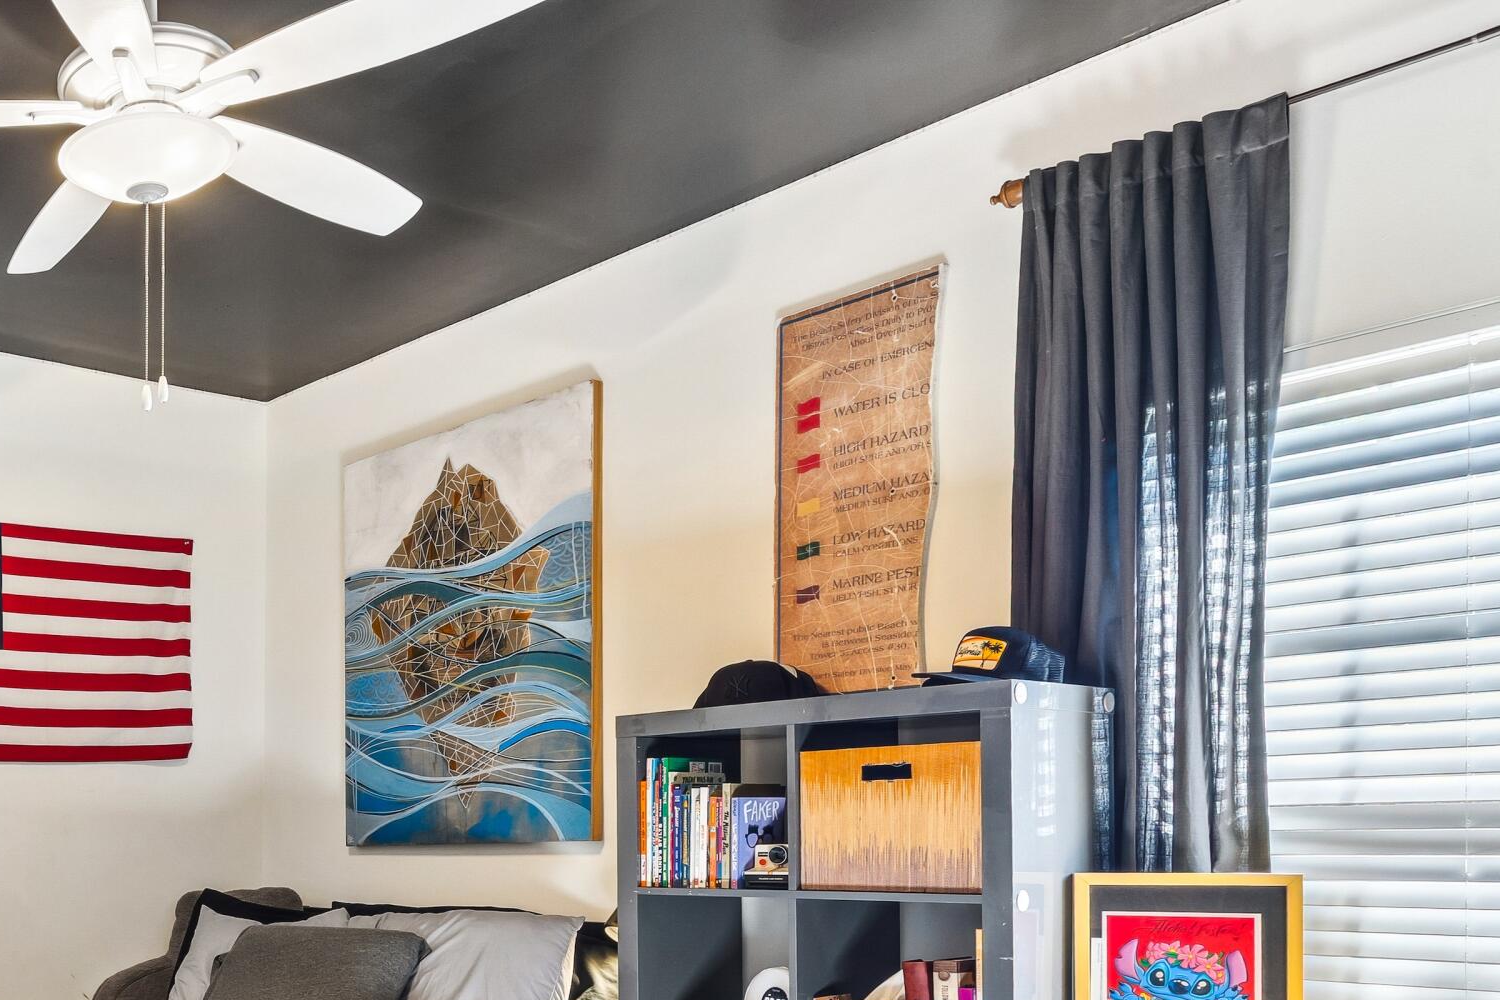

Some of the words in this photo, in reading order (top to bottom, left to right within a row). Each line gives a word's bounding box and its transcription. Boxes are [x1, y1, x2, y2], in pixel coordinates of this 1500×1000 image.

[834, 361, 861, 377] CASE
[863, 358, 877, 367] OF
[833, 397, 880, 418] WATER
[885, 392, 897, 404] IS
[834, 437, 866, 457] HIGH
[870, 424, 929, 448] HAZARD
[833, 480, 886, 501] MEDIUM
[890, 470, 932, 488] HAZA
[833, 531, 864, 545] LOW
[868, 518, 925, 538] HAZARD
[832, 574, 882, 590] MARINE
[875, 631, 912, 641] Seaside
[877, 620, 907, 631] Beach
[743, 800, 780, 823] FAKER
